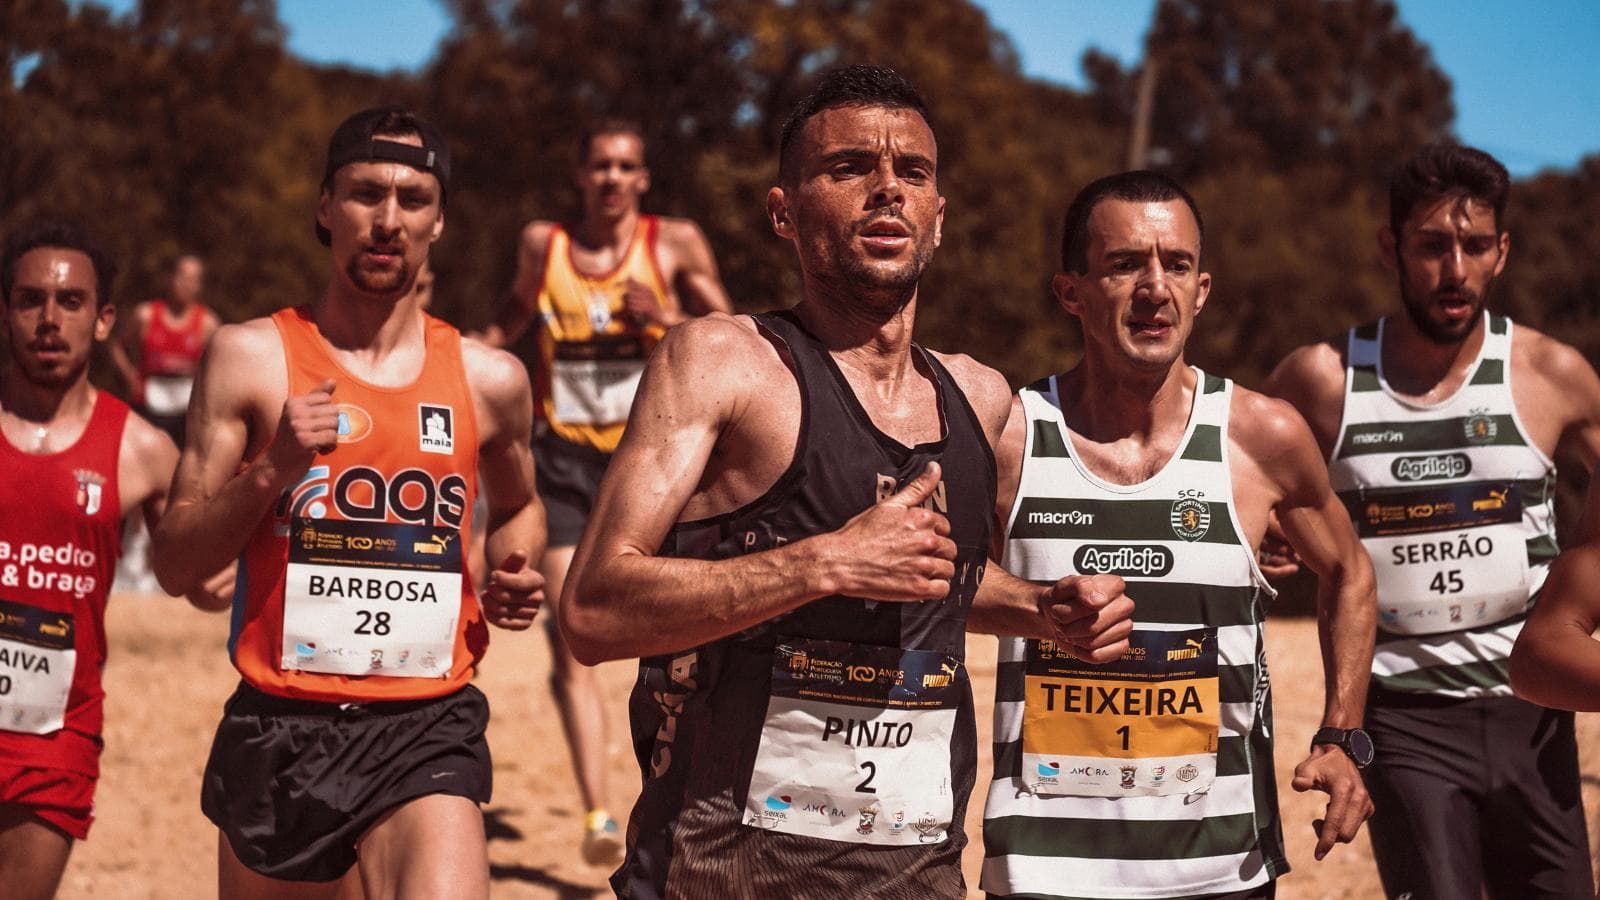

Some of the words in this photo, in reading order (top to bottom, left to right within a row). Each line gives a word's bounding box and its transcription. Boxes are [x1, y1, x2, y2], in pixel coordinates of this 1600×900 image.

[422, 437, 452, 448] maia
[1353, 430, 1403, 444] macron
[1398, 457, 1465, 479] Agriloja
[1177, 489, 1205, 498] SCP
[1028, 511, 1093, 525] macron
[1082, 547, 1166, 575] Agriloja
[1392, 534, 1493, 565] SERRÃO
[2, 564, 19, 586] &
[1429, 569, 1464, 595] 45
[309, 575, 437, 603] BARBOSA
[354, 610, 391, 636] 28
[1167, 648, 1198, 661] PUMA
[878, 668, 905, 679] ANOS
[922, 674, 949, 688] PUMA
[1040, 683, 1203, 716] TEIXEIRA
[821, 716, 913, 748] PINTO
[1115, 725, 1130, 751] 1
[855, 760, 877, 794] 2
